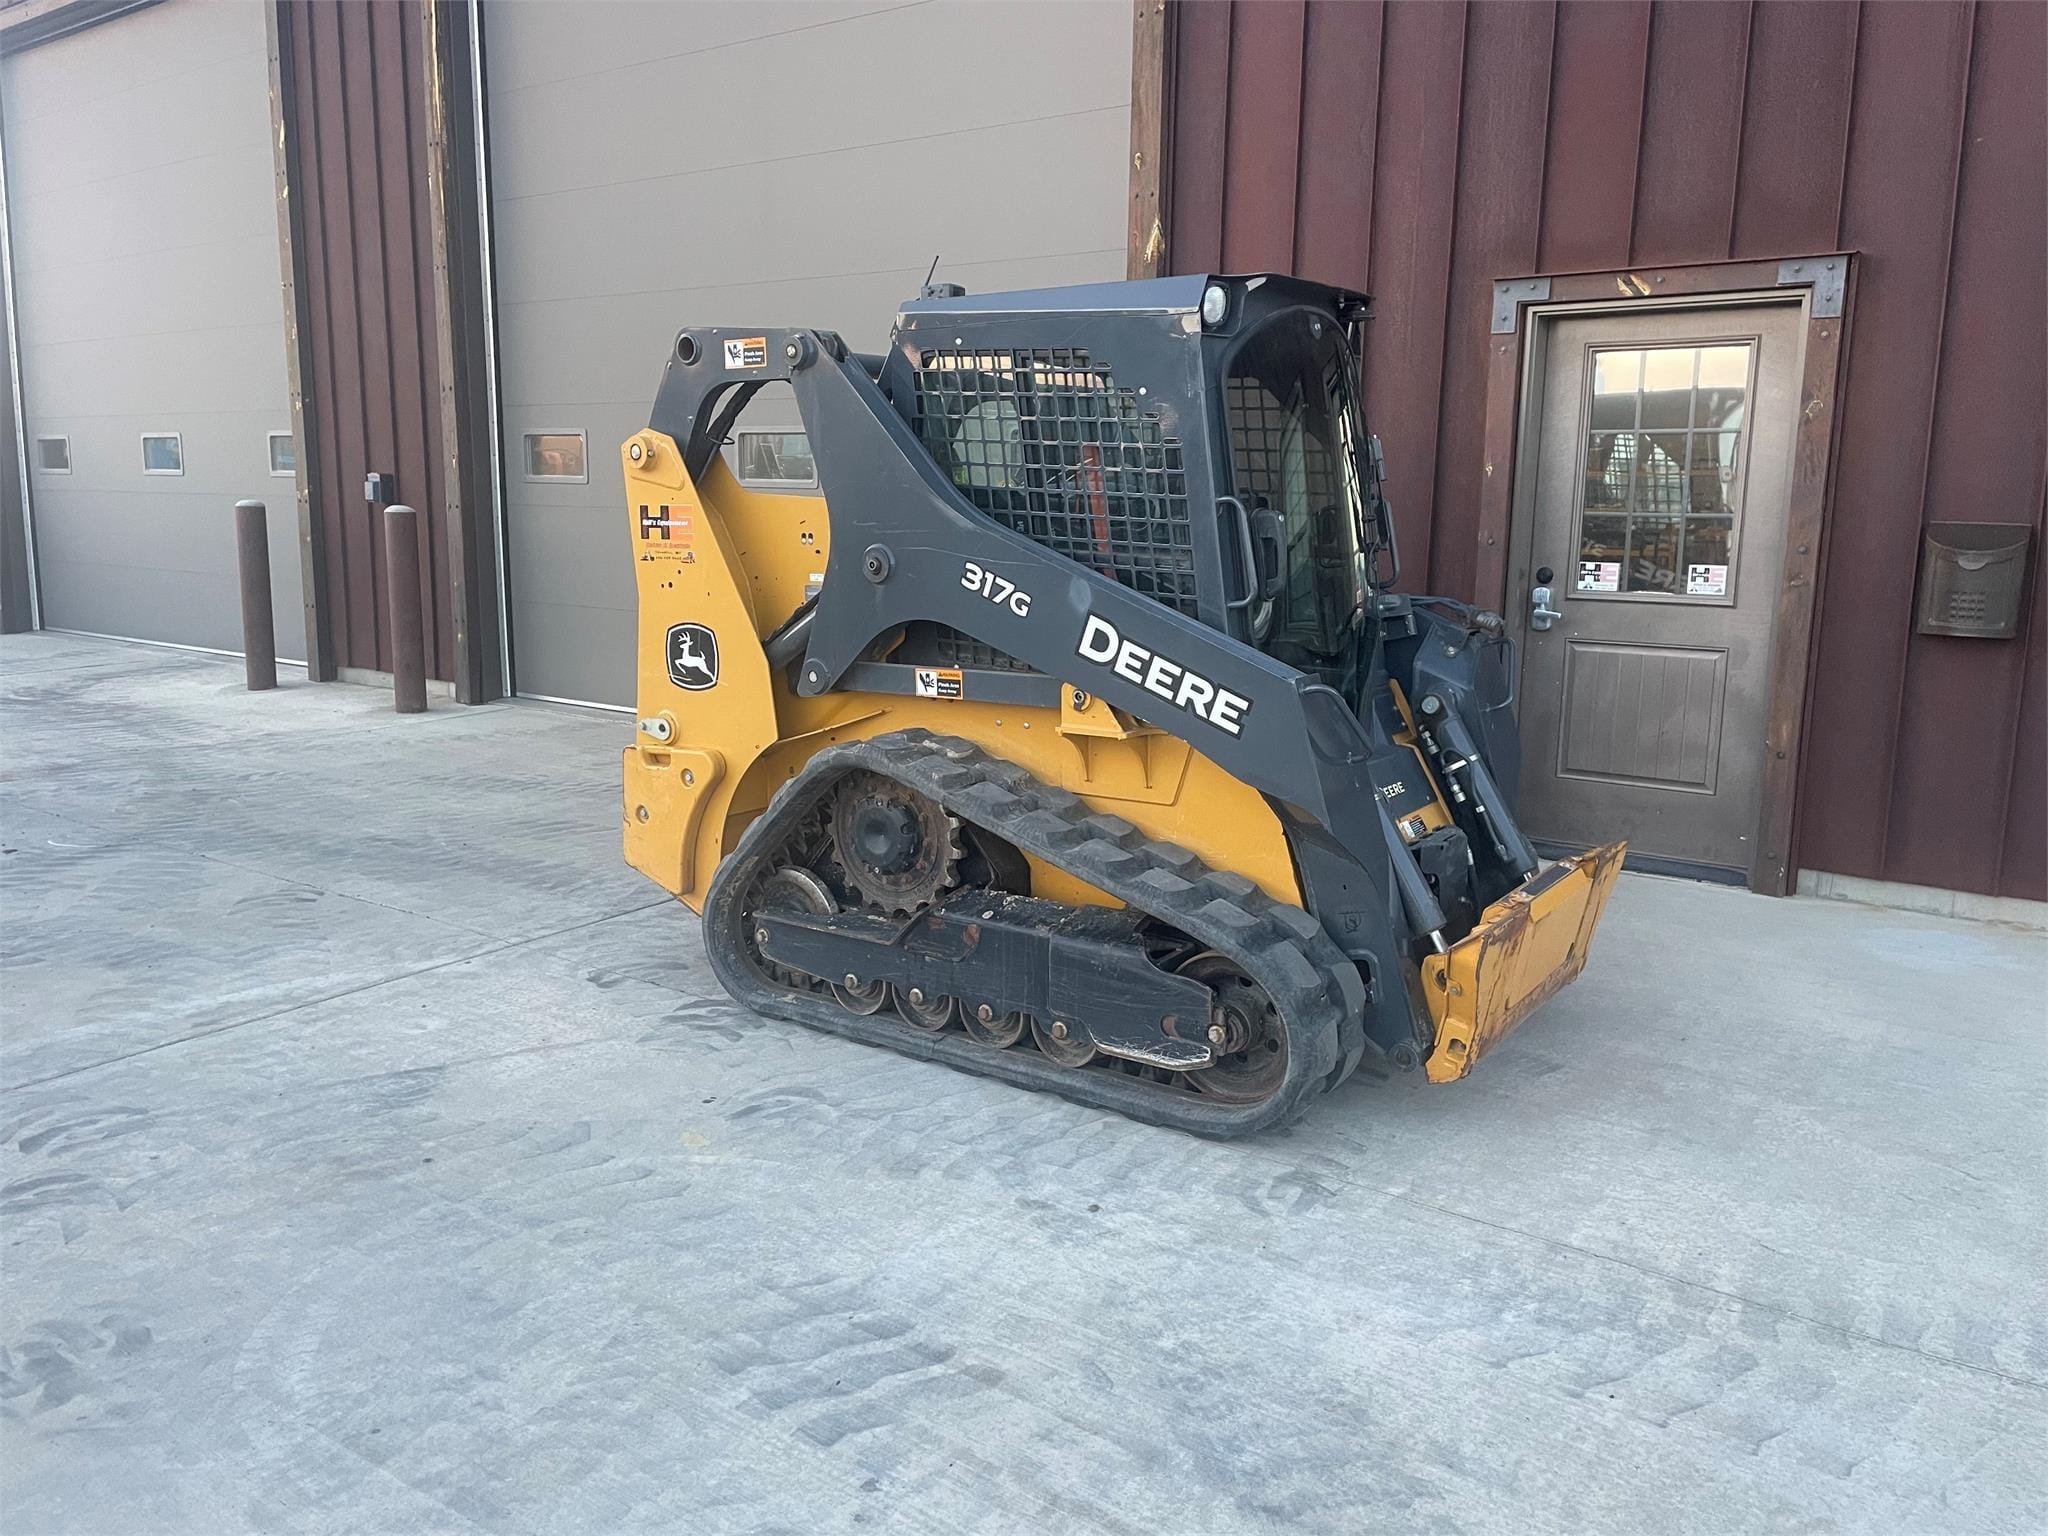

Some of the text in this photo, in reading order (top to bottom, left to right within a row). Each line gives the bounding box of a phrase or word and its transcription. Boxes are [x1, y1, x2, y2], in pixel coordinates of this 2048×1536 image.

[961, 562, 1032, 618] 317G
[1078, 614, 1249, 736] DEERE
[1382, 781, 1405, 798] EERE
